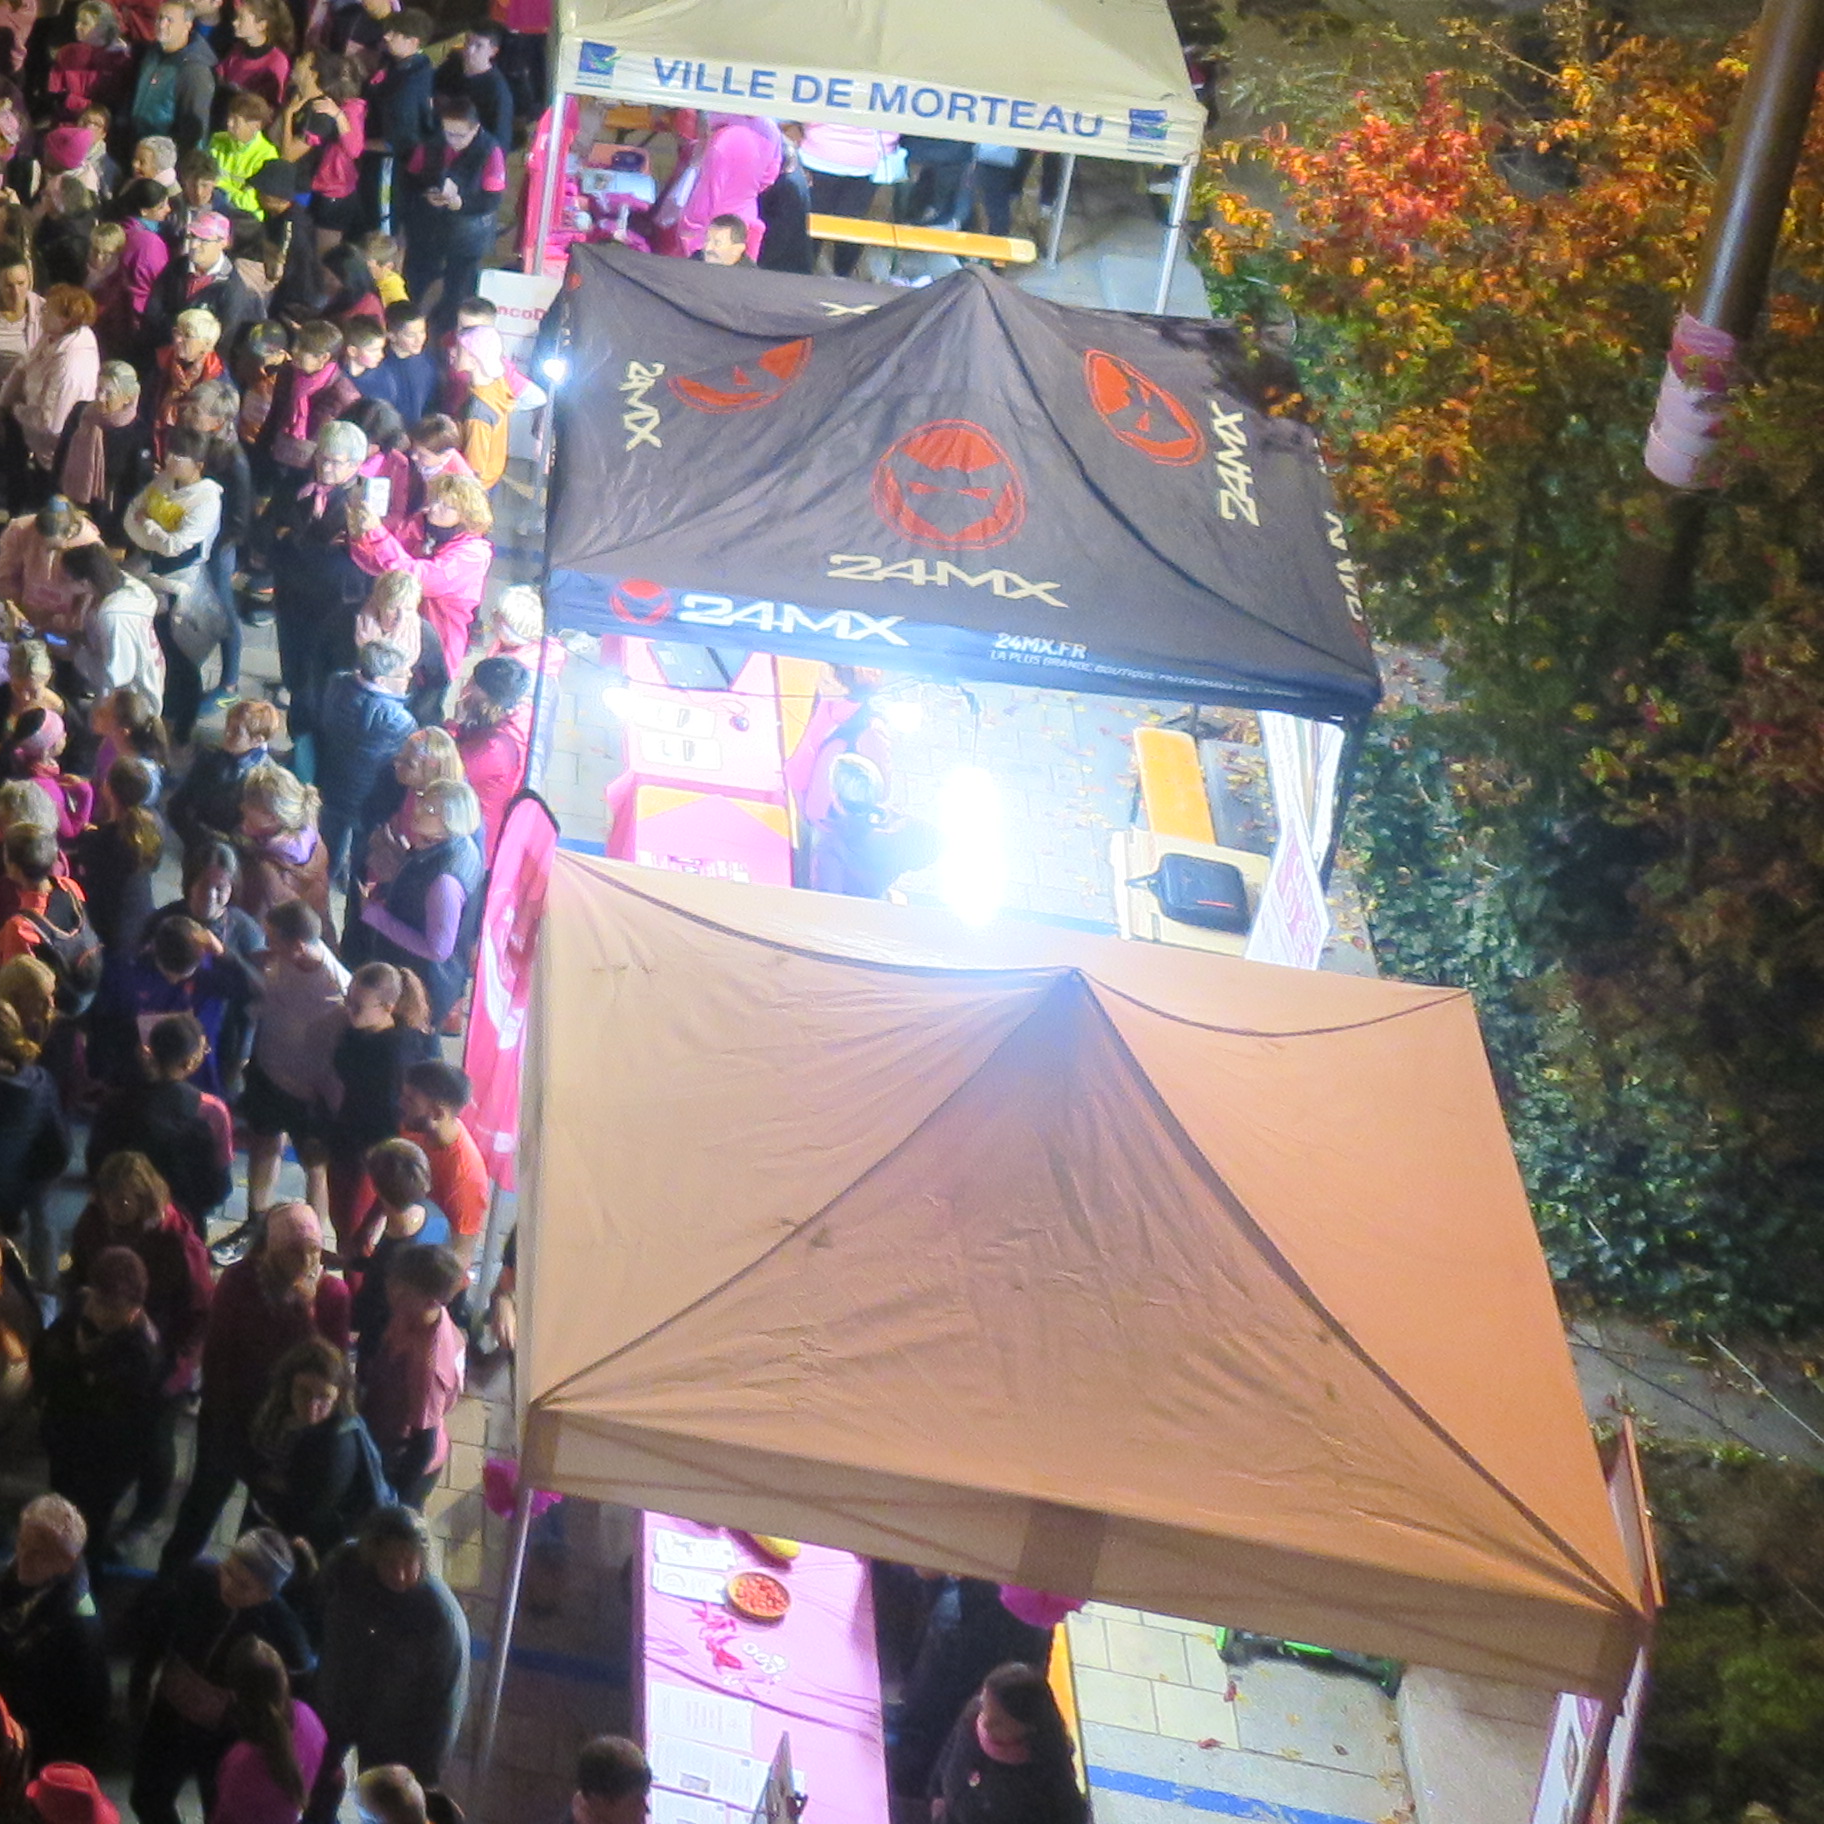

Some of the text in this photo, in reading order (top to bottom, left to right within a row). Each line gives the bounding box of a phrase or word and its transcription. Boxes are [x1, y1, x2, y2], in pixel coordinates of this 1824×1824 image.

[654, 57, 1104, 138] VILLE DE MORTEAU
[618, 360, 665, 452] 24MX
[1210, 399, 1261, 528] 24MX
[827, 553, 1069, 609] 24MX
[679, 593, 910, 647] 24MX
[994, 632, 1088, 660] 24MX.FR
[1010, 652, 1040, 666] PLUS
